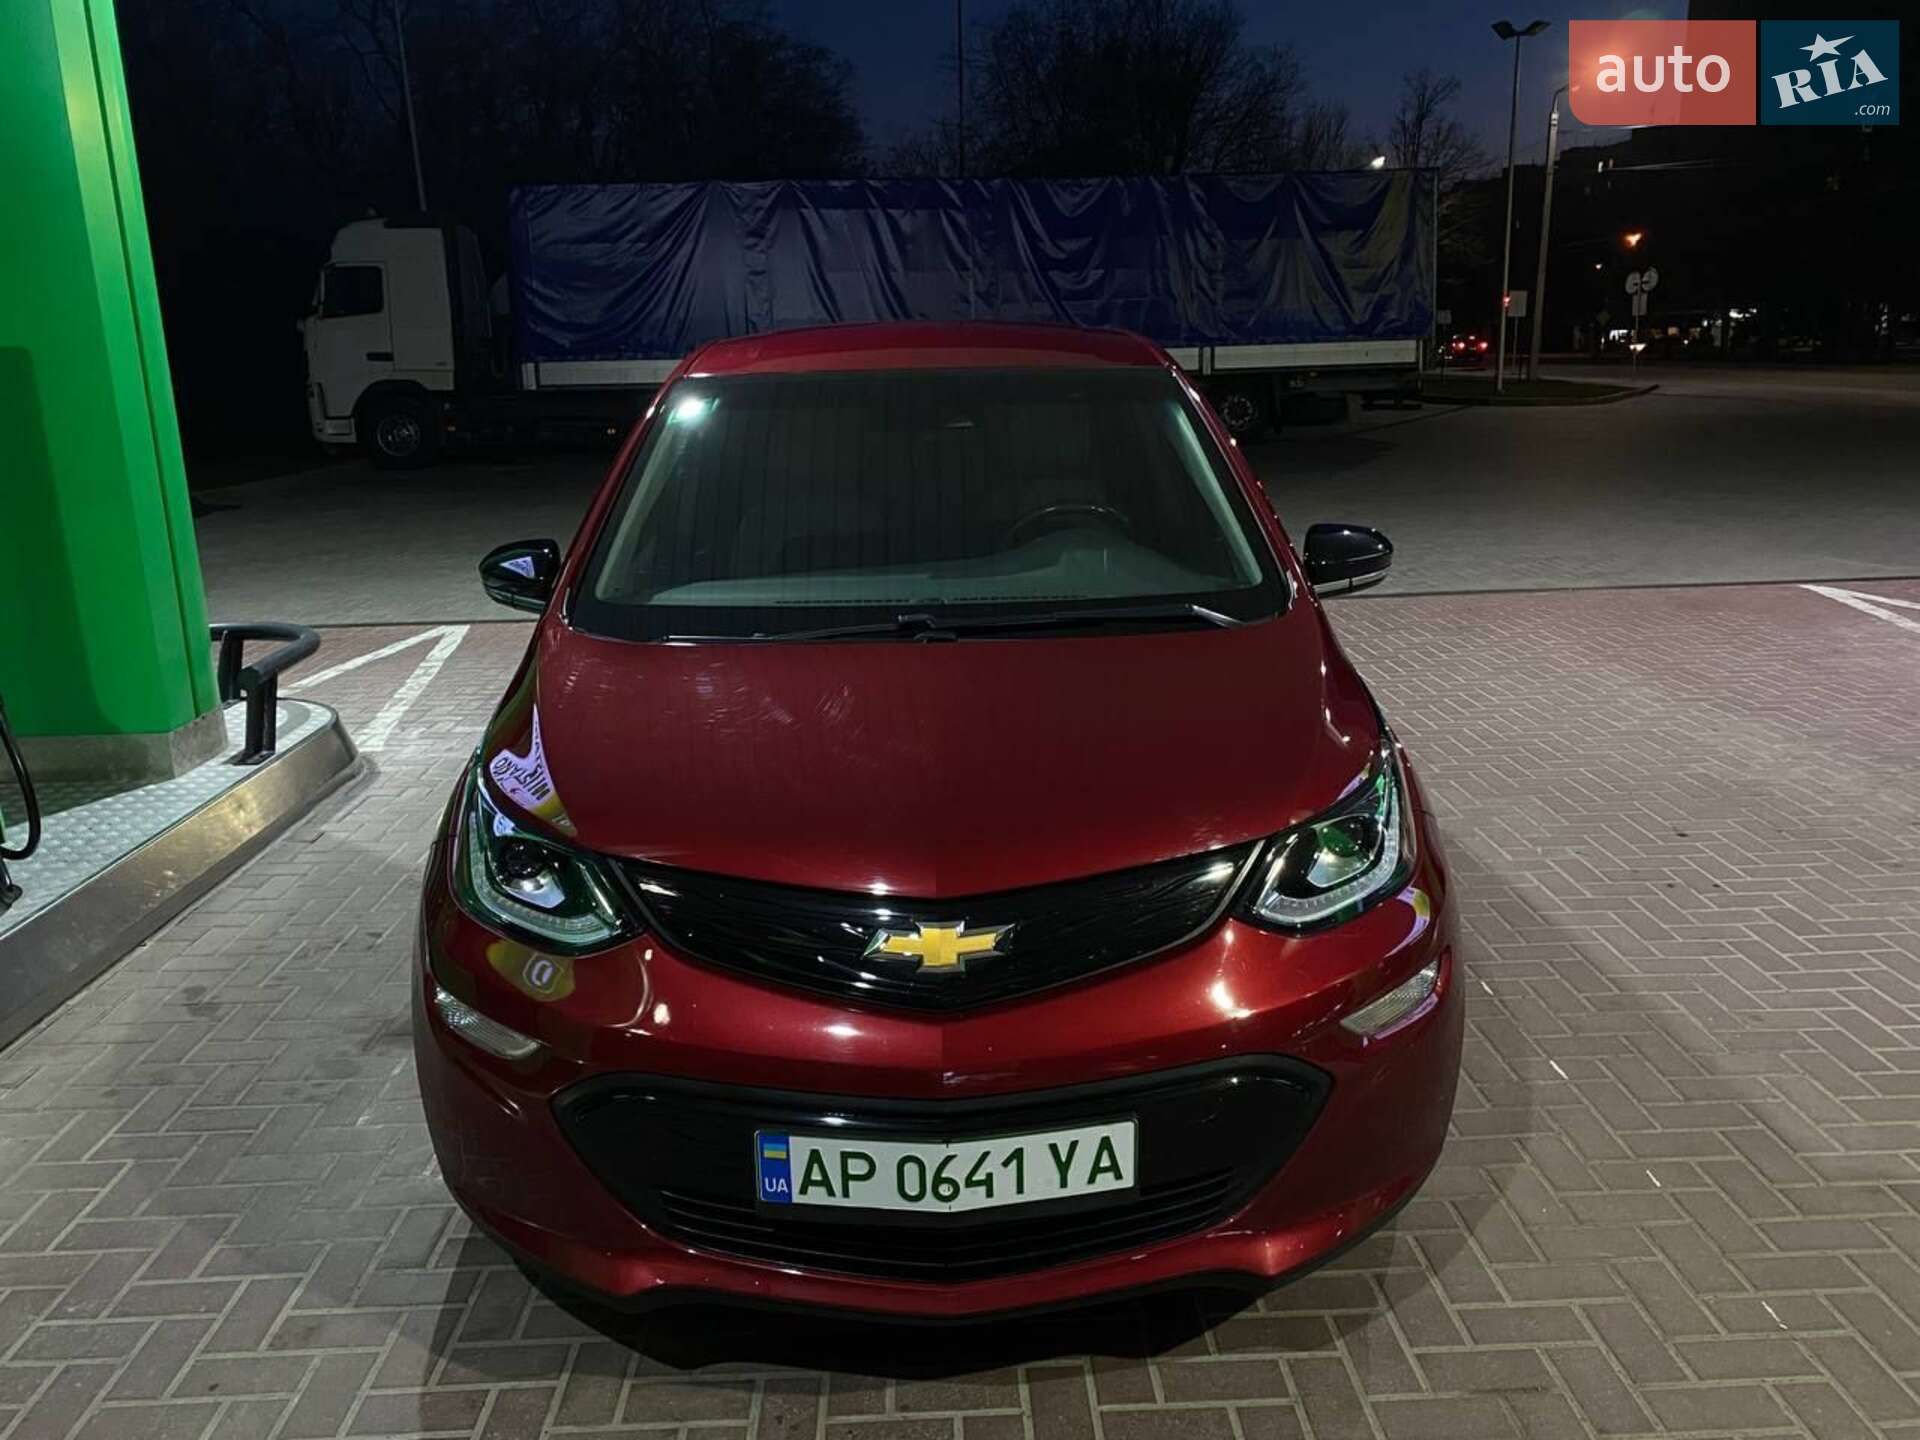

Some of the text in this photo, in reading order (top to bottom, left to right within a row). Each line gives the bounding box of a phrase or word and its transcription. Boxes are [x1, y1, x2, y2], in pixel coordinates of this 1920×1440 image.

[764, 1178, 789, 1193] UA
[798, 1135, 1123, 1203] AP 0641 YA
